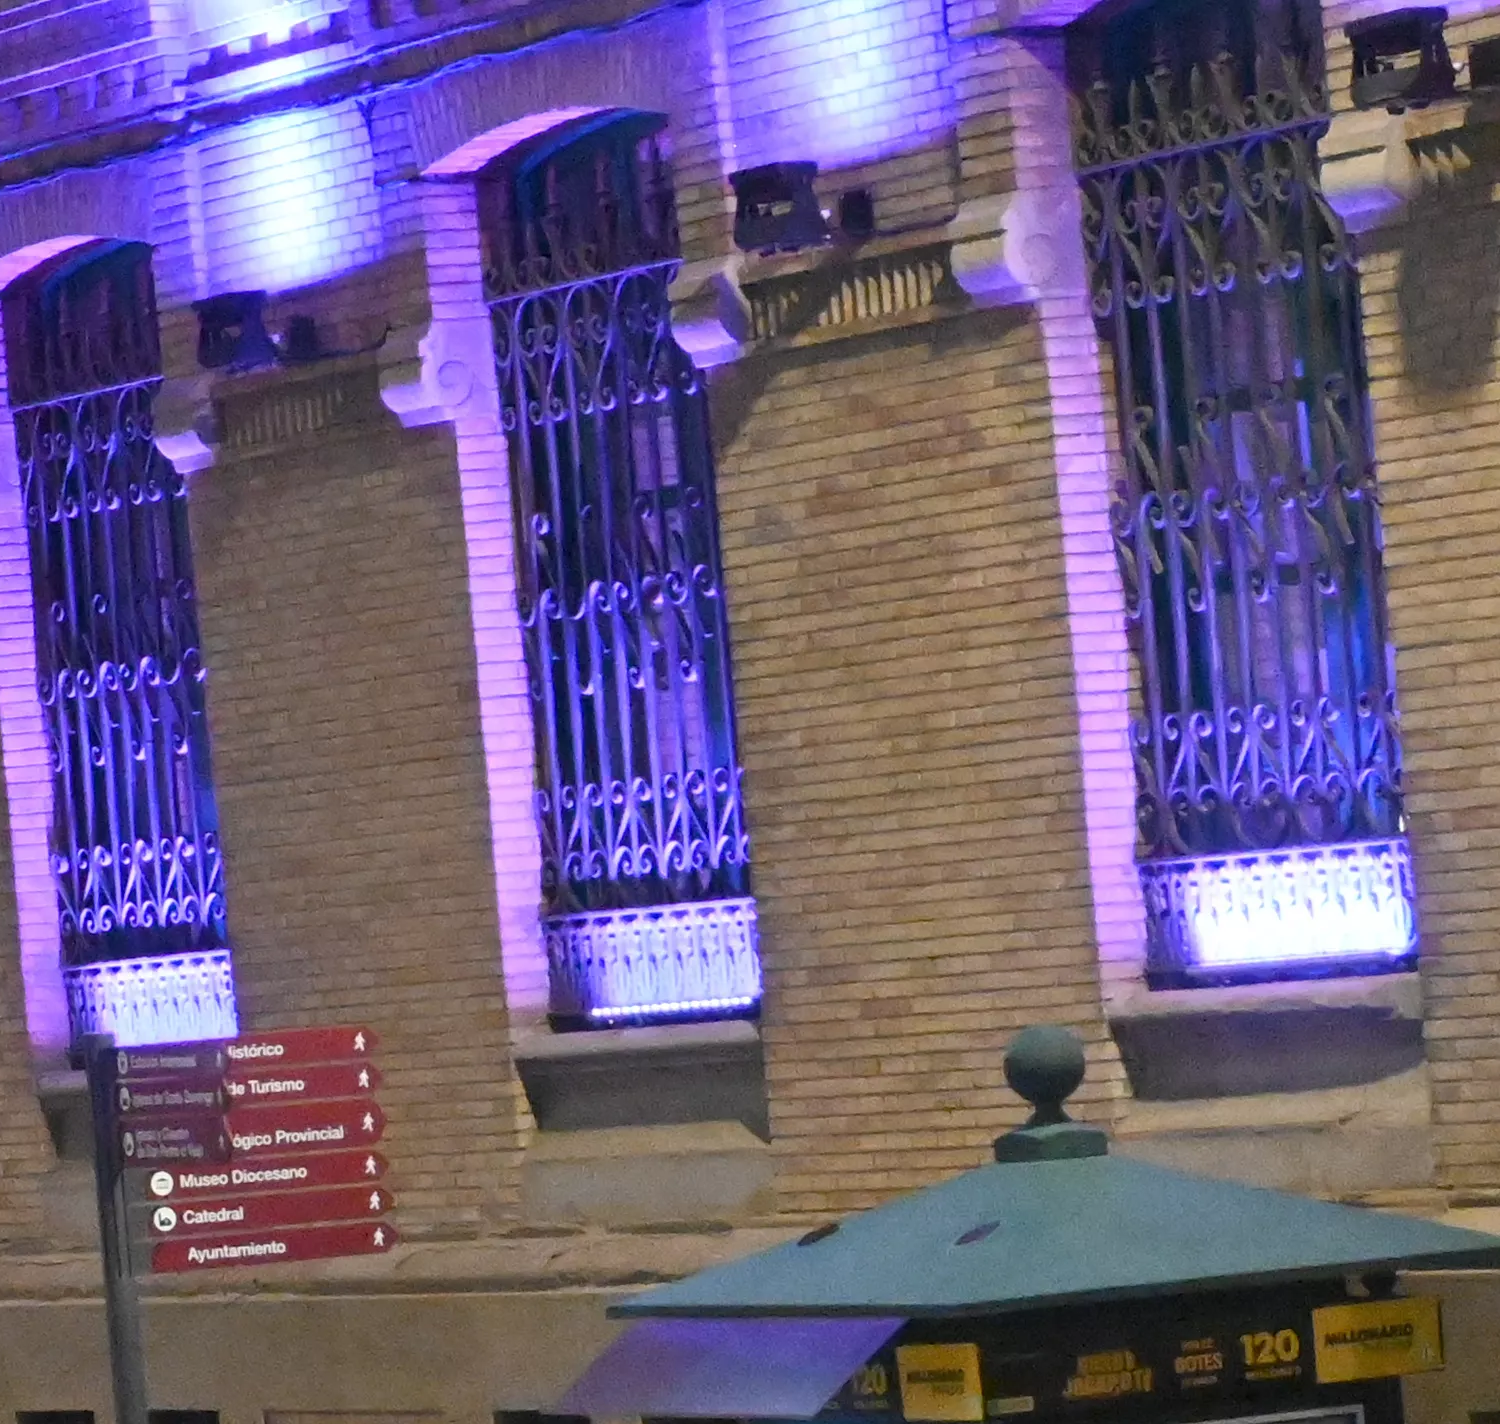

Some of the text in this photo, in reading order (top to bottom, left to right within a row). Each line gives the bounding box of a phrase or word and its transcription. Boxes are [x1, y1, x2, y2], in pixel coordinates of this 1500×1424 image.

[248, 1078, 305, 1094] Turismo
[275, 1125, 344, 1144] Provincial
[180, 1167, 308, 1188] Museo Diocesano
[182, 1205, 244, 1224] Catedral
[188, 1240, 286, 1264] Ayuntamiento
[1240, 1328, 1300, 1366] 120
